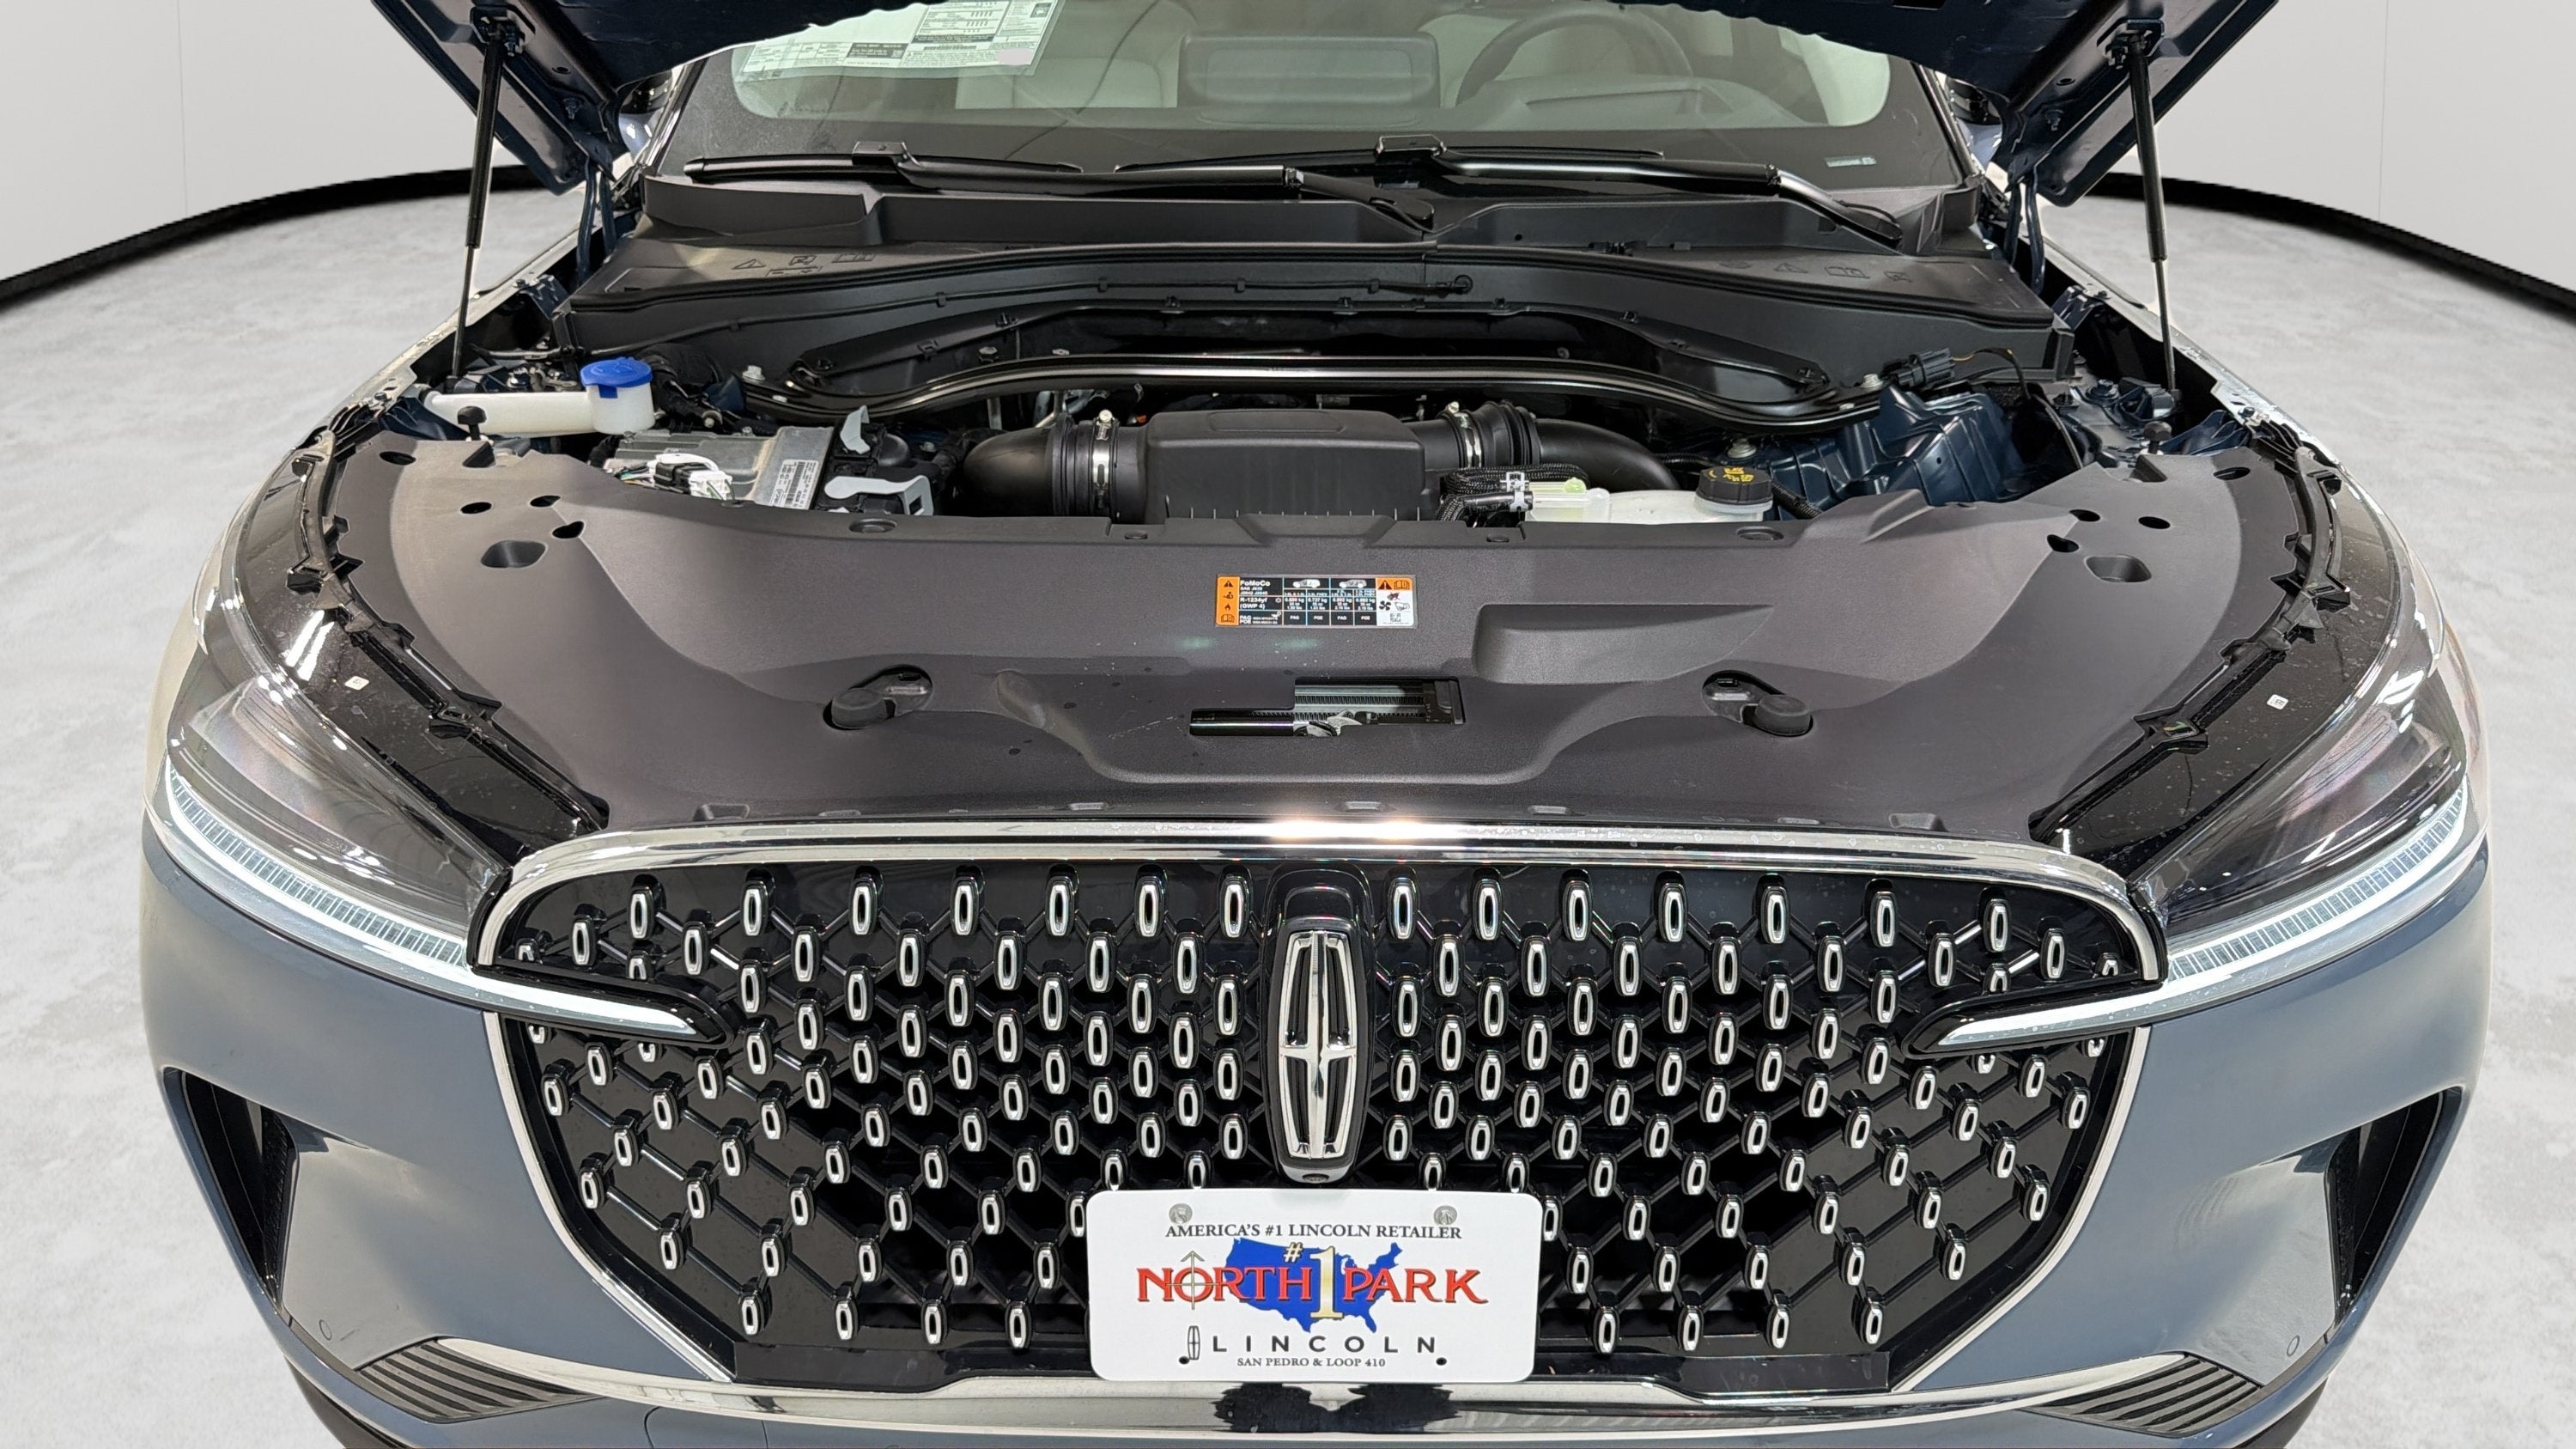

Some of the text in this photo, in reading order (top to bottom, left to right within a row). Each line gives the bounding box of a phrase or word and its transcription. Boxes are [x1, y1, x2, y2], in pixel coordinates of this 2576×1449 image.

[1165, 1224, 1462, 1239] AMERICA'S #1 LINCOLN RETAILER
[1136, 1266, 1489, 1305] NORTH PARK
[1212, 1335, 1435, 1353] LINCOLN
[1236, 1357, 1386, 1367] SAN PEDRO & LOOP 410
